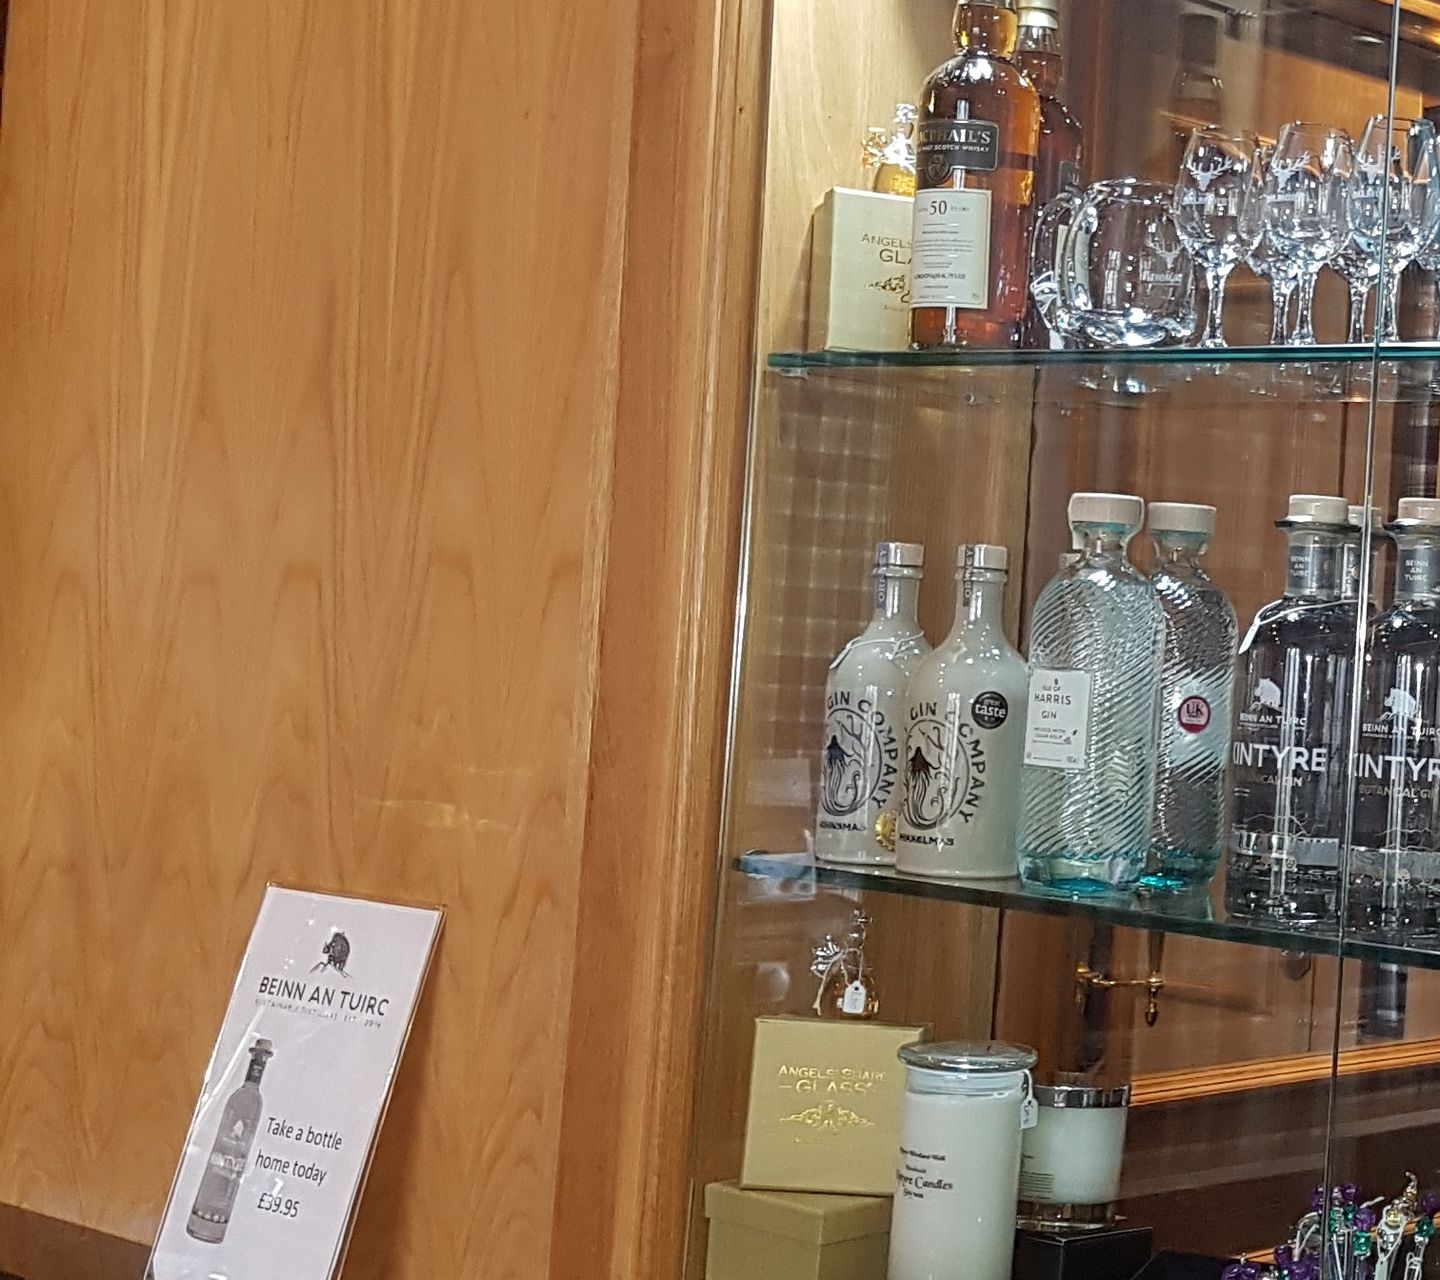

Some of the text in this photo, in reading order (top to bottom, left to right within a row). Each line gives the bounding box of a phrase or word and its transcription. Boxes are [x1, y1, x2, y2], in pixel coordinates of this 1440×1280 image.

[919, 128, 991, 145] ACPHAIL'S
[929, 199, 948, 215] 50
[1034, 693, 1072, 706] HARRIS
[910, 702, 938, 721] GIN
[975, 705, 1006, 719] taste
[1041, 710, 1057, 719] GIN
[1258, 714, 1273, 724] AN
[1362, 723, 1388, 733] BEINN
[827, 691, 898, 808] GIN COMPANY
[259, 976, 389, 1016] BEINN AN TUIRC
[267, 1117, 342, 1151] Take a bottle
[255, 1149, 290, 1174] home
[292, 1161, 327, 1187] today
[915, 1176, 953, 1190] Candles
[257, 1193, 300, 1218] £39.95
